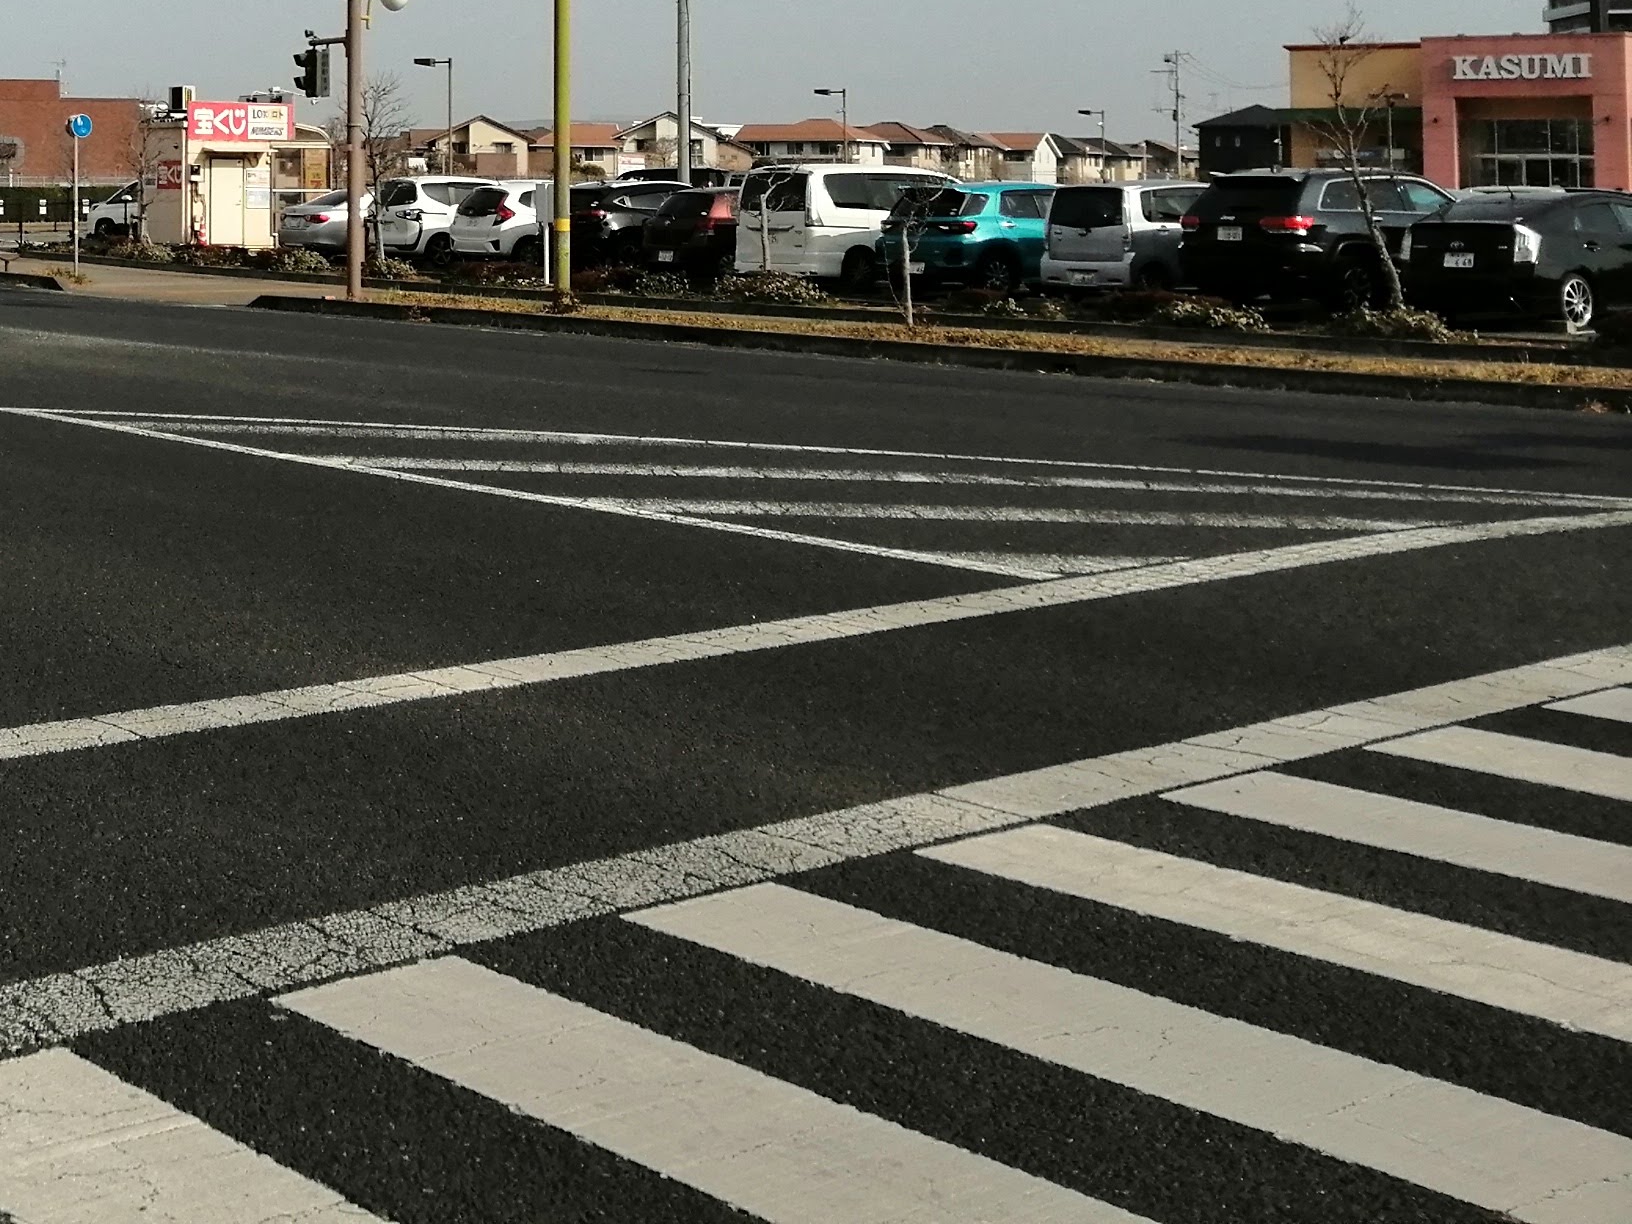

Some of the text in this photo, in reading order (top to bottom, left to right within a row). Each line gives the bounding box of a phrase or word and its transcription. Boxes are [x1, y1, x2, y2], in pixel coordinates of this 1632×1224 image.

[1452, 53, 1593, 80] KASUMI
[193, 108, 246, 136] 宝くじ
